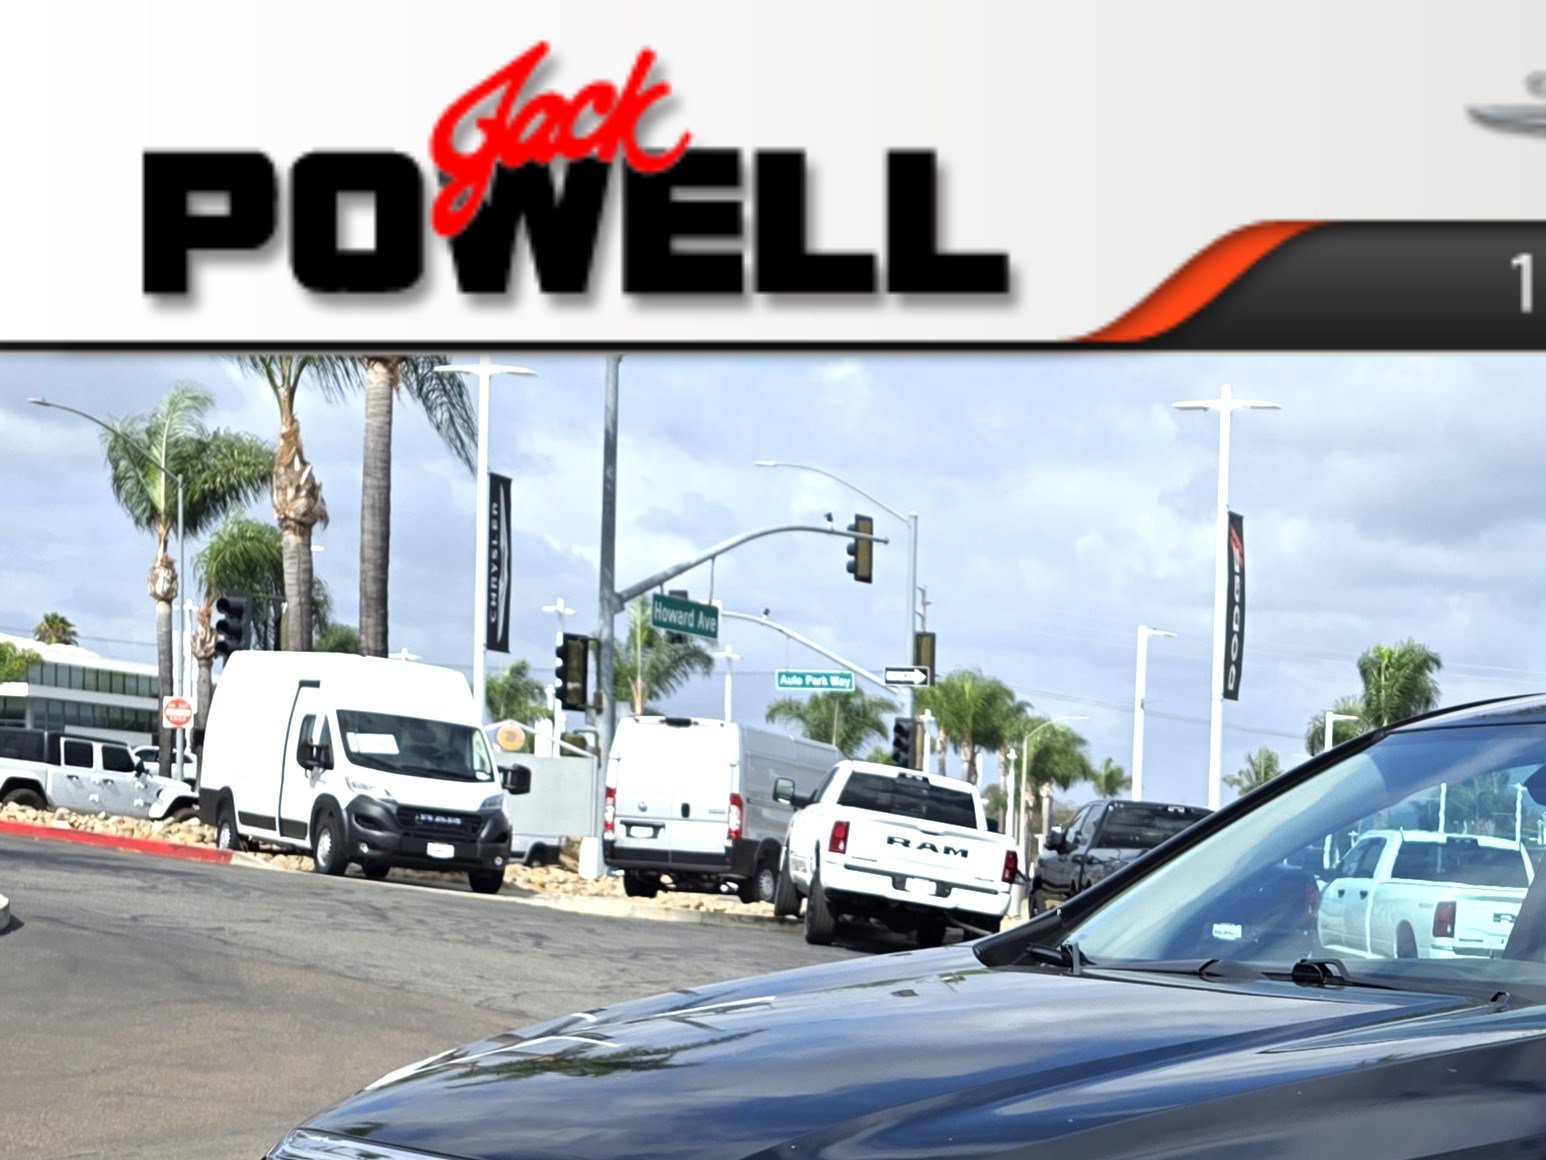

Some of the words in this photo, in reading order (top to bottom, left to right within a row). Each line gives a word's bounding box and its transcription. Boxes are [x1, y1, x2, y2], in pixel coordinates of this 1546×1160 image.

[653, 599, 695, 629] Howard
[696, 610, 718, 634] Ave
[779, 672, 803, 687] Auto
[805, 673, 829, 687] Park
[830, 674, 851, 690] Way
[886, 835, 969, 859] RAM
